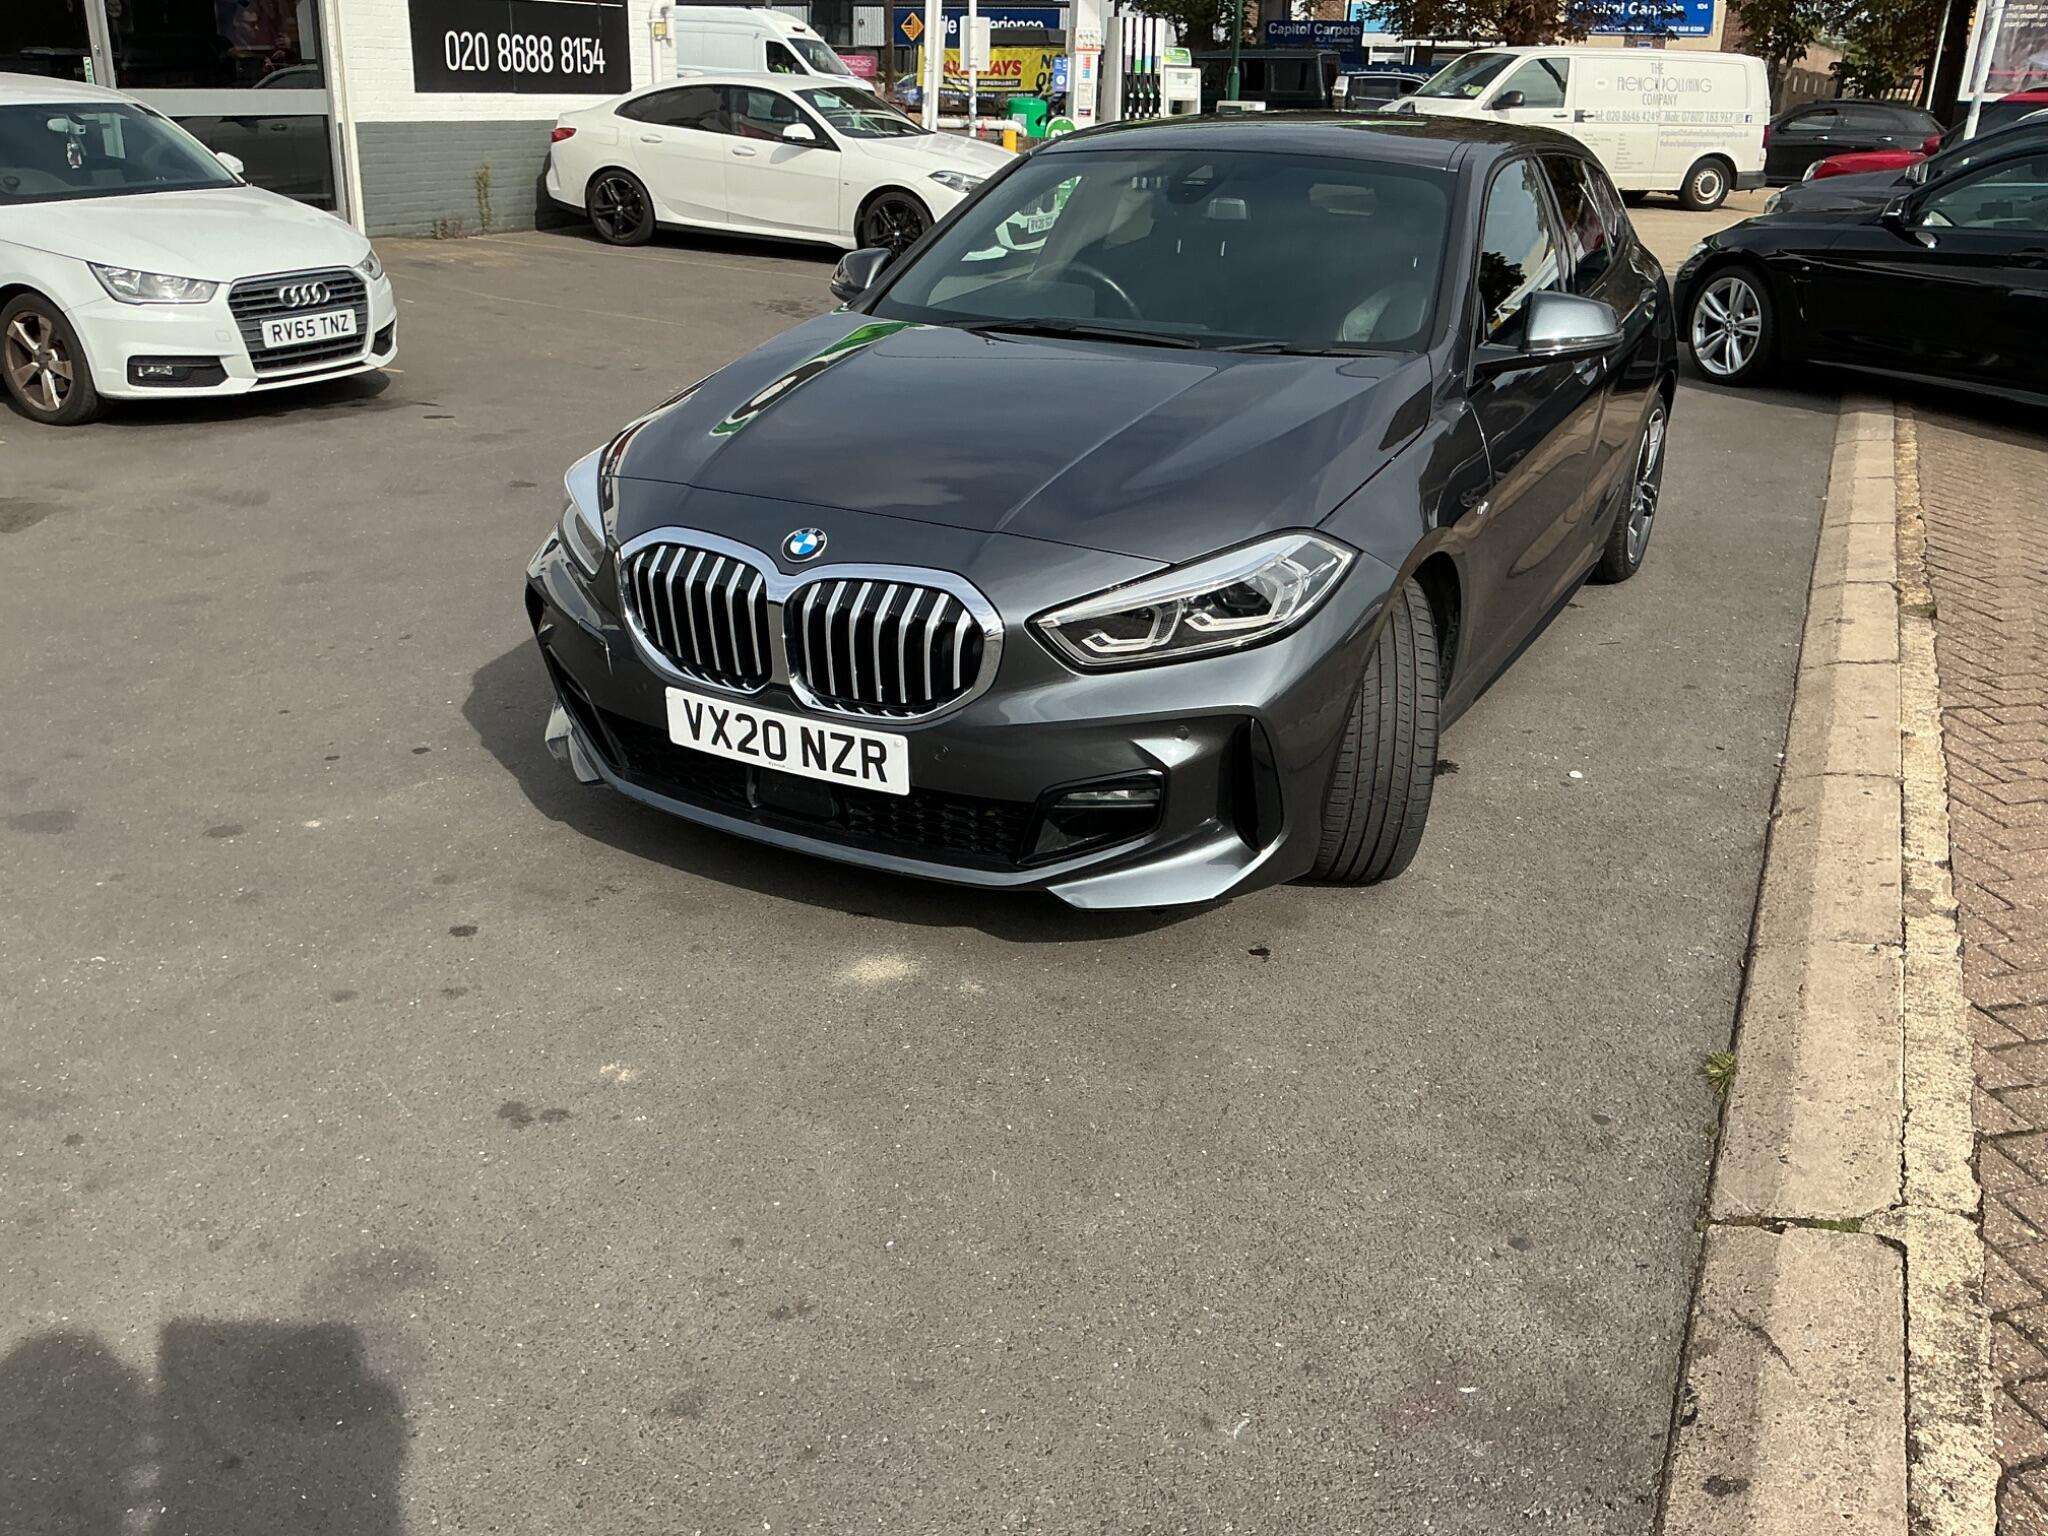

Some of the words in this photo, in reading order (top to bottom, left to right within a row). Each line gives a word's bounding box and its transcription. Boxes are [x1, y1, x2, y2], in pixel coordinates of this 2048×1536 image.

[1268, 23, 1311, 37] Capitol
[1314, 23, 1360, 37] Carpets
[444, 30, 490, 71] 020
[497, 33, 554, 73] 8688
[560, 36, 606, 74] 8154
[1650, 62, 1664, 75] THE
[1642, 93, 1678, 106] COMPANY
[1606, 110, 1620, 121] 020
[271, 319, 316, 343] RV65
[319, 314, 349, 335] TNZ
[683, 698, 787, 762] VX20
[800, 726, 888, 783] NZR
